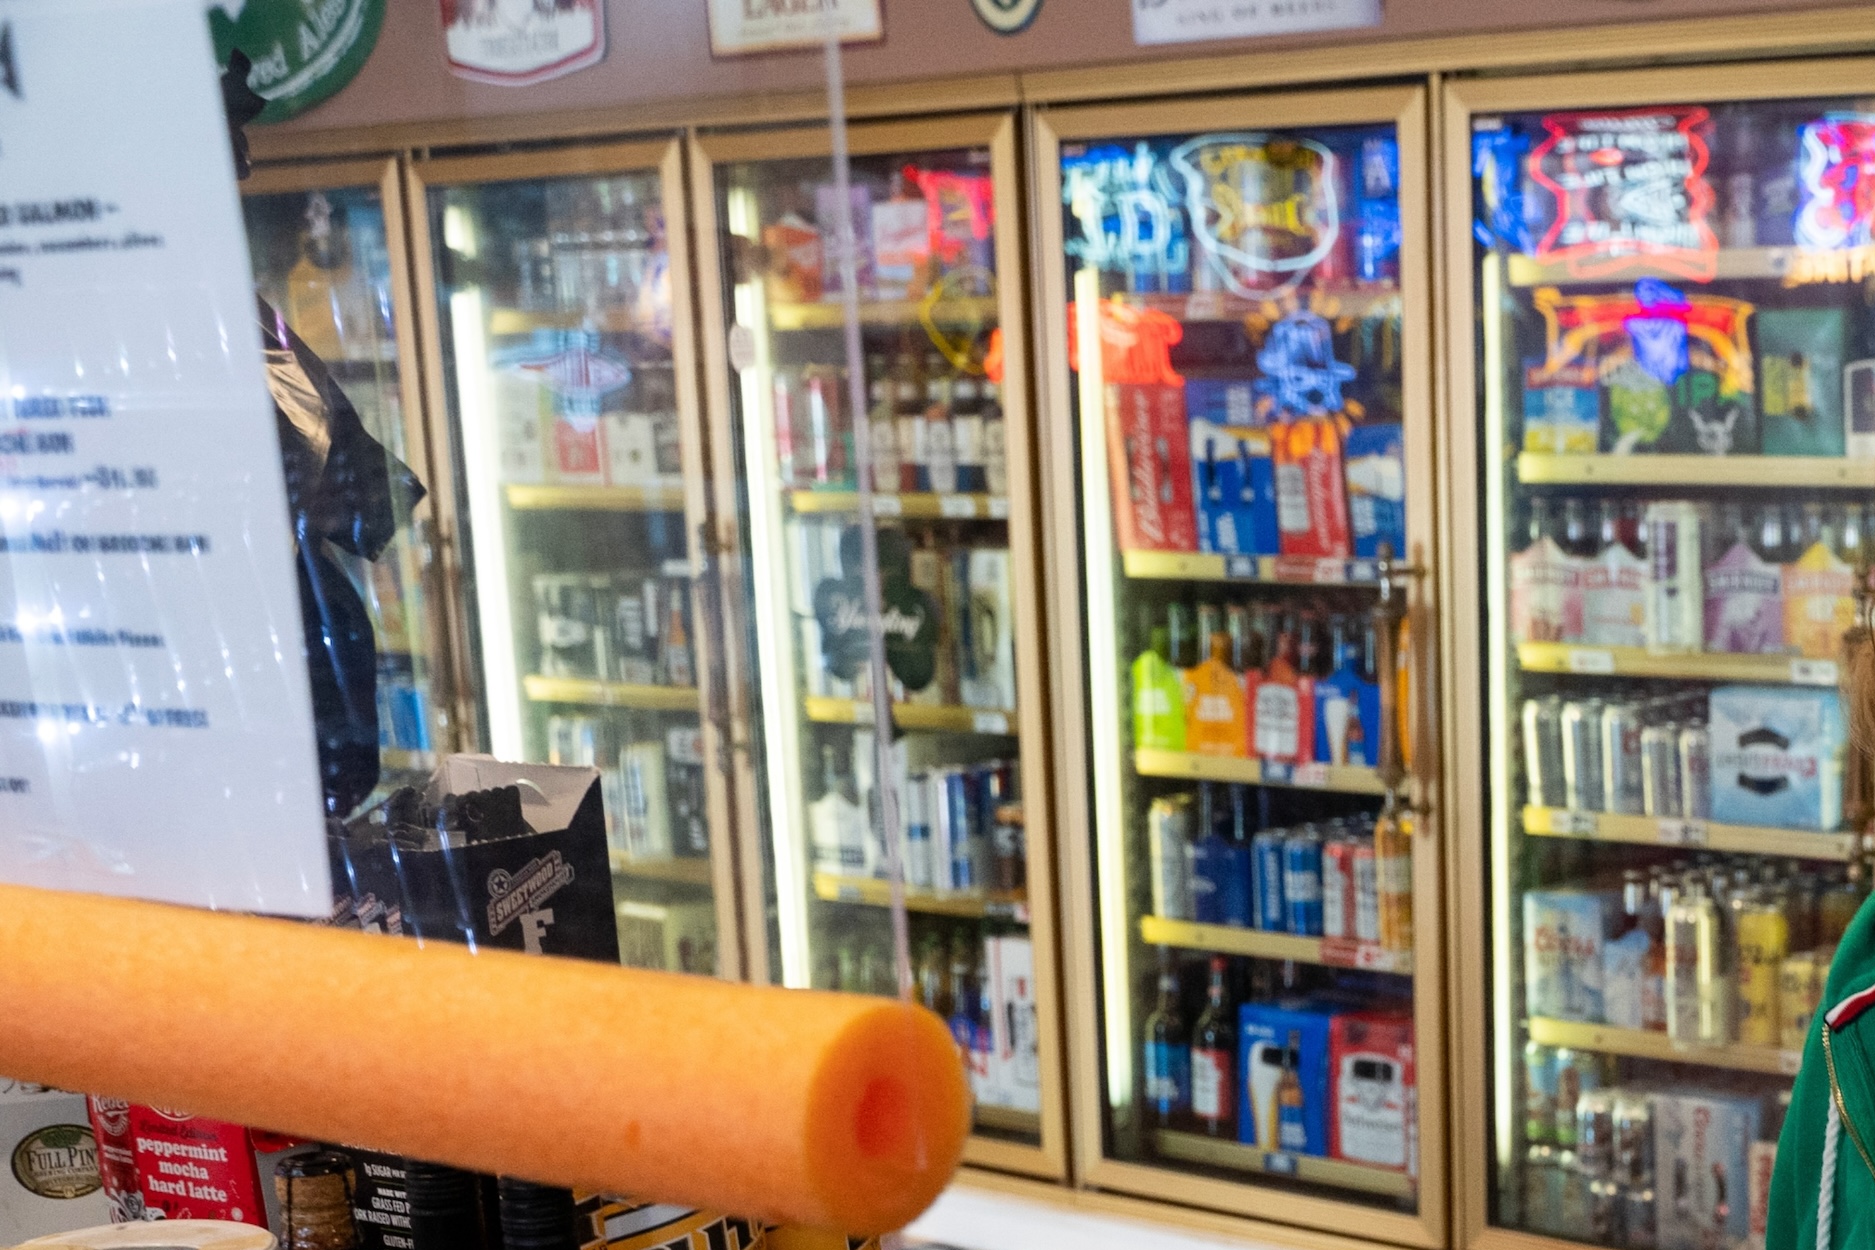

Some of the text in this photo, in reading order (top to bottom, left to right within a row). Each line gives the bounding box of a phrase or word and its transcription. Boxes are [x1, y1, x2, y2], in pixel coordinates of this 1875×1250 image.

[495, 860, 556, 917] SWEETWOOD
[27, 1149, 67, 1172] FULL
[68, 1146, 95, 1167] PIN
[136, 1136, 229, 1163] peppermint
[159, 1159, 210, 1180] mocha
[372, 1163, 392, 1178] SUGAR
[148, 1175, 229, 1203] hard latte
[394, 1190, 407, 1200] WIT
[371, 1196, 405, 1213] GRASS FED
[354, 1207, 413, 1229] ORK RAISED WITHO
[383, 1233, 415, 1250] GLUTEN-F
